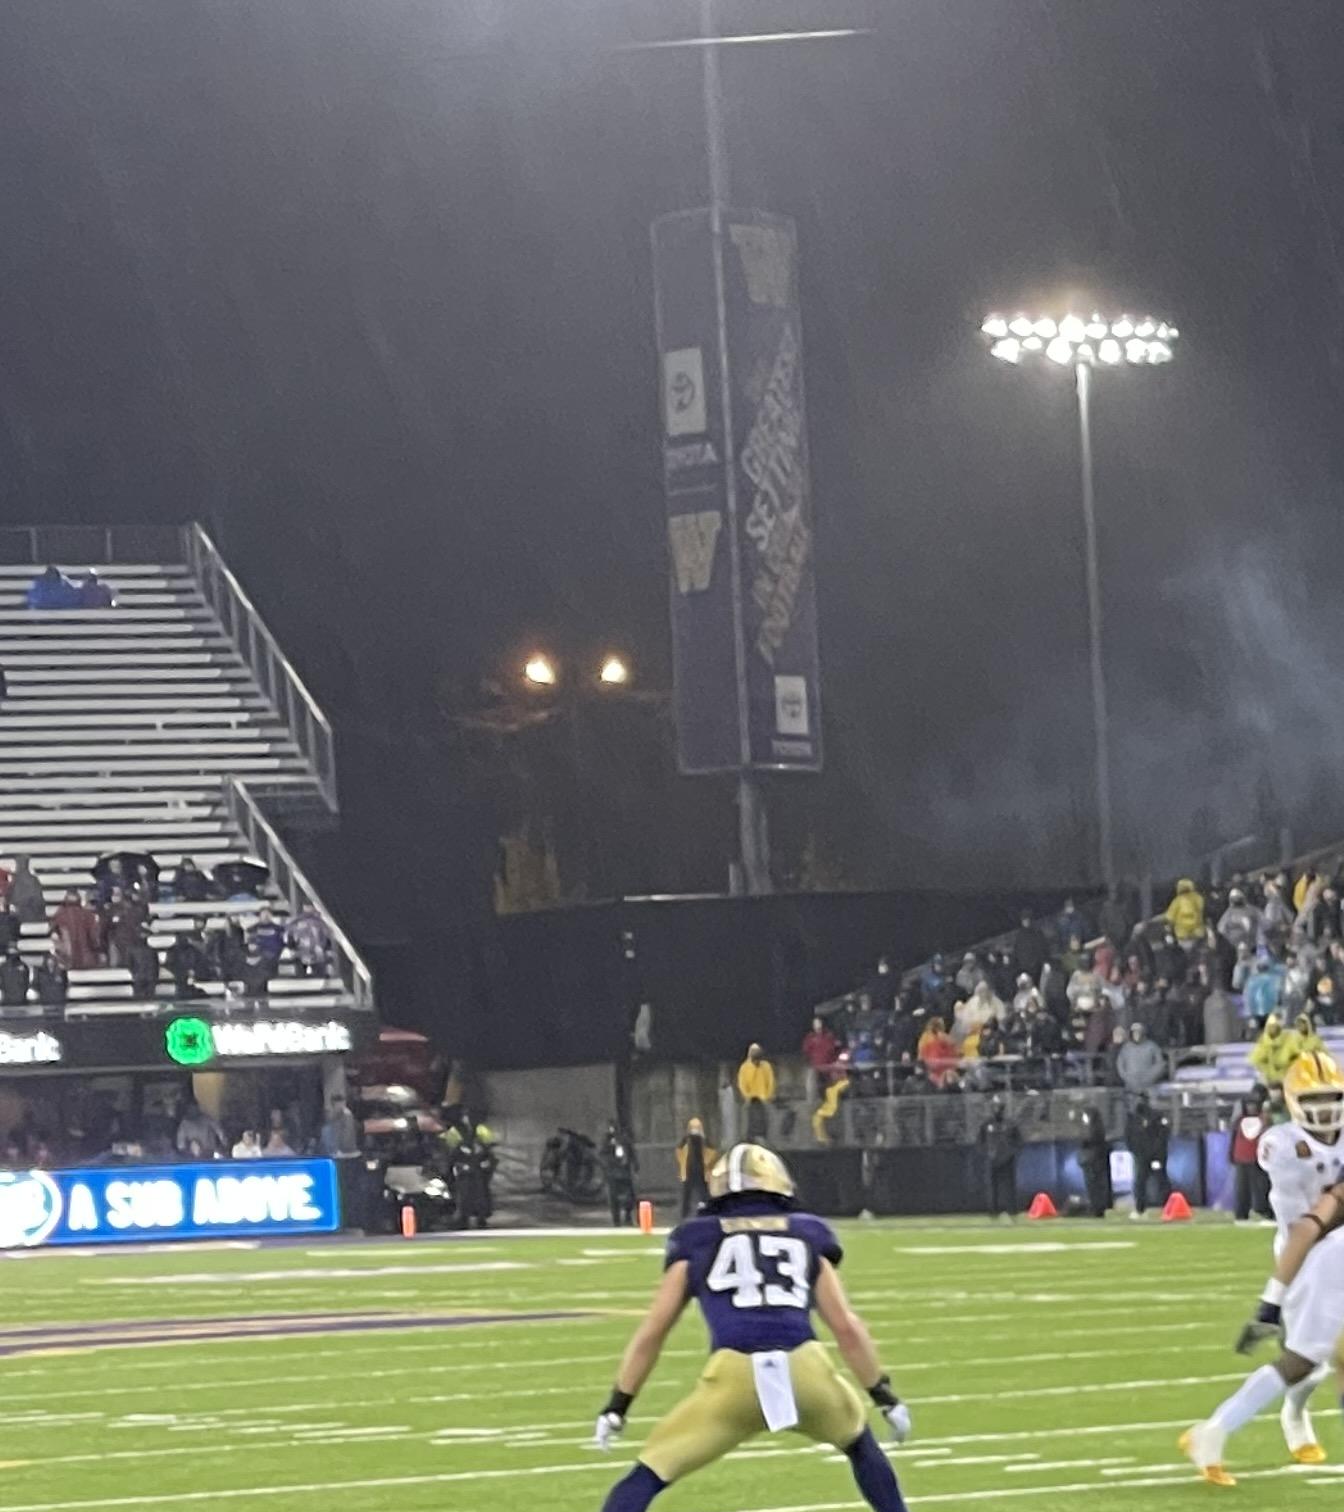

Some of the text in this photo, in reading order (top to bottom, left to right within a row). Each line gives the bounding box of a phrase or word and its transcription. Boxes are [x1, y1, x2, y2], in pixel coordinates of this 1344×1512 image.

[68, 1183, 99, 1231] A
[105, 1179, 185, 1229] SUB
[706, 1233, 811, 1309] 43
